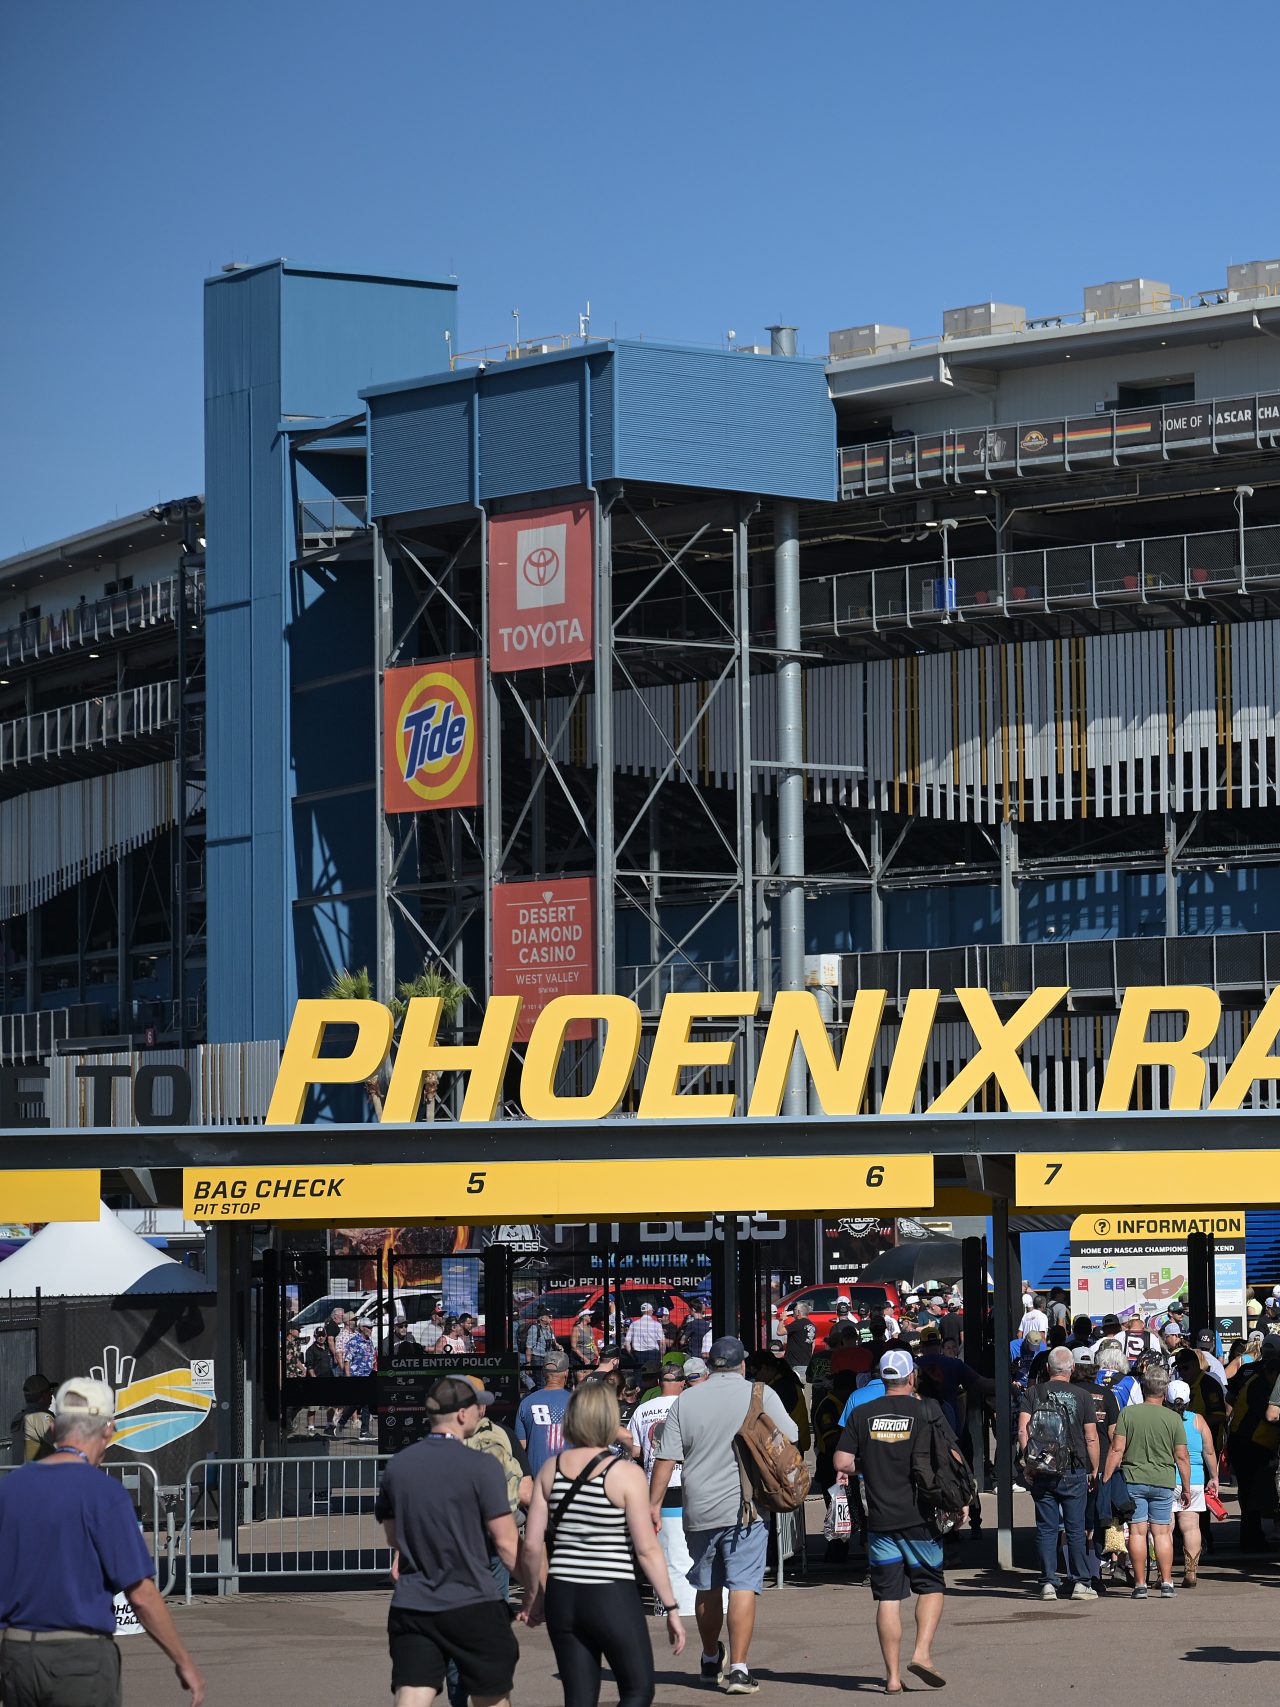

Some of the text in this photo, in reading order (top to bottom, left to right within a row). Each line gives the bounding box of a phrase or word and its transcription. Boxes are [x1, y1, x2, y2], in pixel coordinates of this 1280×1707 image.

[1190, 415, 1203, 428] OF
[1208, 409, 1252, 426] NASCAR
[499, 618, 585, 652] TOYOTA
[403, 701, 468, 783] Tide
[519, 905, 576, 925] DESERT
[511, 924, 582, 945] DIAMOND
[519, 945, 576, 964] CASINO
[516, 971, 580, 985] WEST VALLEY
[265, 986, 1071, 1126] PHOENIX
[75, 1064, 191, 1128] TO
[466, 1172, 486, 1194] 5
[865, 1165, 885, 1187] 6
[1043, 1163, 1063, 1185] 7
[193, 1177, 345, 1200] BAG CHECK
[193, 1202, 261, 1215] PIT STOP
[1117, 1218, 1241, 1234] INFORMATION
[1081, 1247, 1102, 1255] HOME
[1144, 1246, 1188, 1254] CHAMPIONS
[391, 1357, 502, 1368] GATE ENTRY POLICY
[531, 1404, 551, 1425] 8
[641, 1408, 663, 1418] WALK
[872, 1418, 910, 1432] BRIXTON
